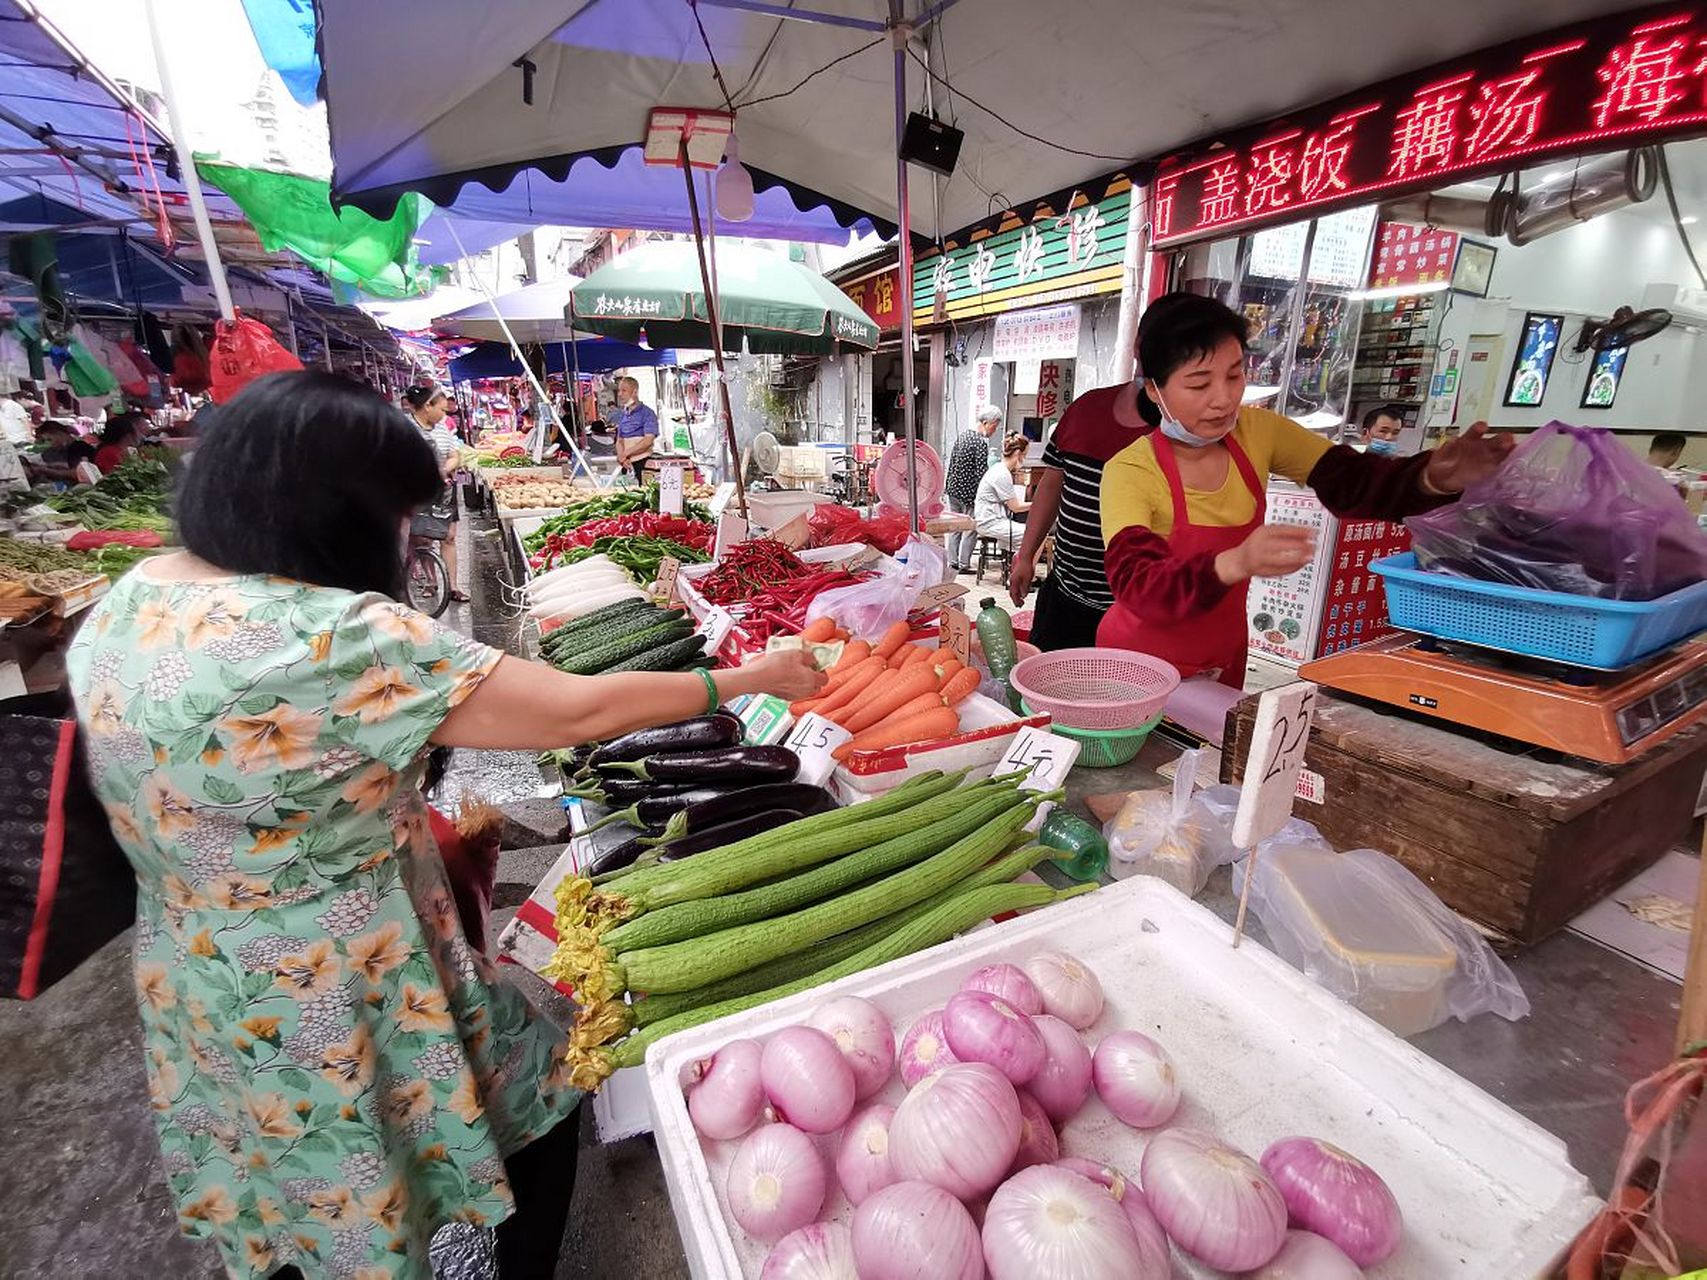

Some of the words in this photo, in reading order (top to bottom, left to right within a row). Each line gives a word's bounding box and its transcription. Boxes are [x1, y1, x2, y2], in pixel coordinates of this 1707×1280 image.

[1197, 124, 1352, 226] 盖浇饭
[1387, 69, 1543, 177] 藕汤
[1592, 40, 1707, 127] 海
[1008, 732, 1054, 777] 4元
